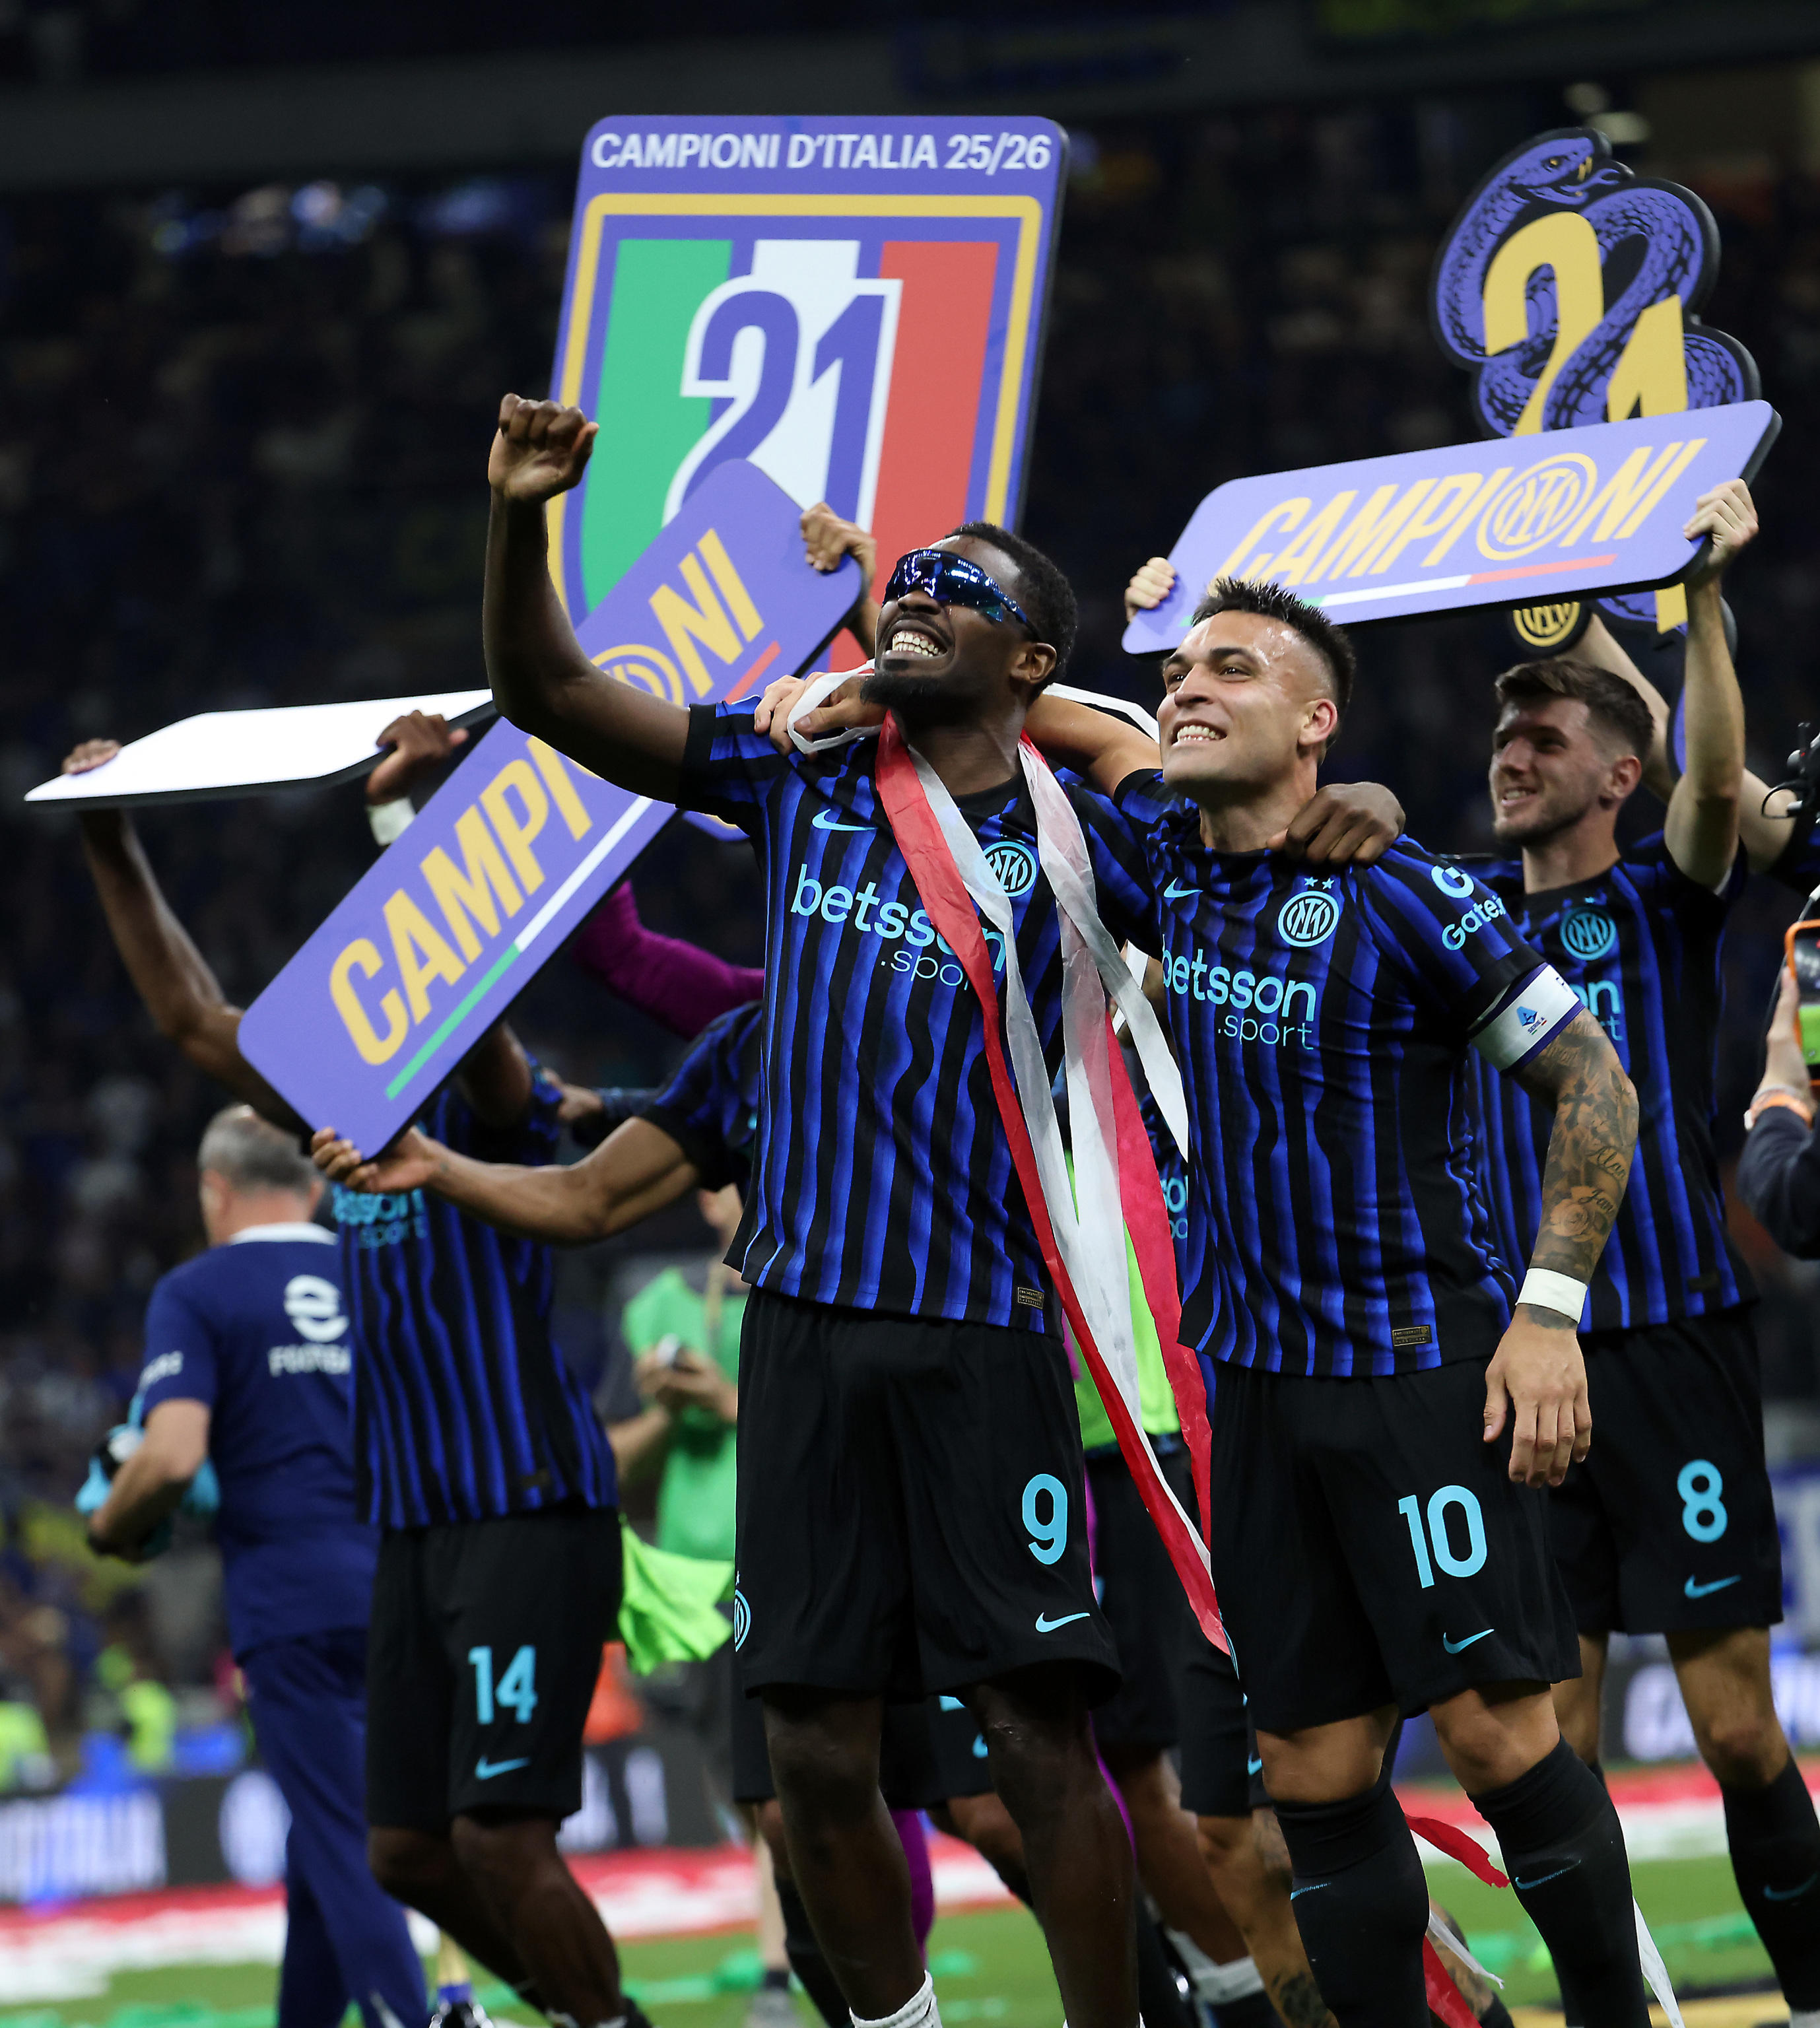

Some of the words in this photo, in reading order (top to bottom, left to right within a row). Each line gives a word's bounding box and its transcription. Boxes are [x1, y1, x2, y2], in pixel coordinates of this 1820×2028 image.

[591, 133, 781, 169] CAMPIONI
[944, 133, 1052, 175] 25/26
[681, 290, 887, 525] 21
[790, 863, 1008, 973] betssn
[881, 950, 995, 990] .spo
[1162, 933, 1316, 1022] betsson
[1217, 1015, 1314, 1050] .sport
[1022, 1473, 1068, 1565] 9
[1398, 1485, 1488, 1589] 10
[1677, 1459, 1728, 1543] 8
[469, 1645, 537, 1724] 14
